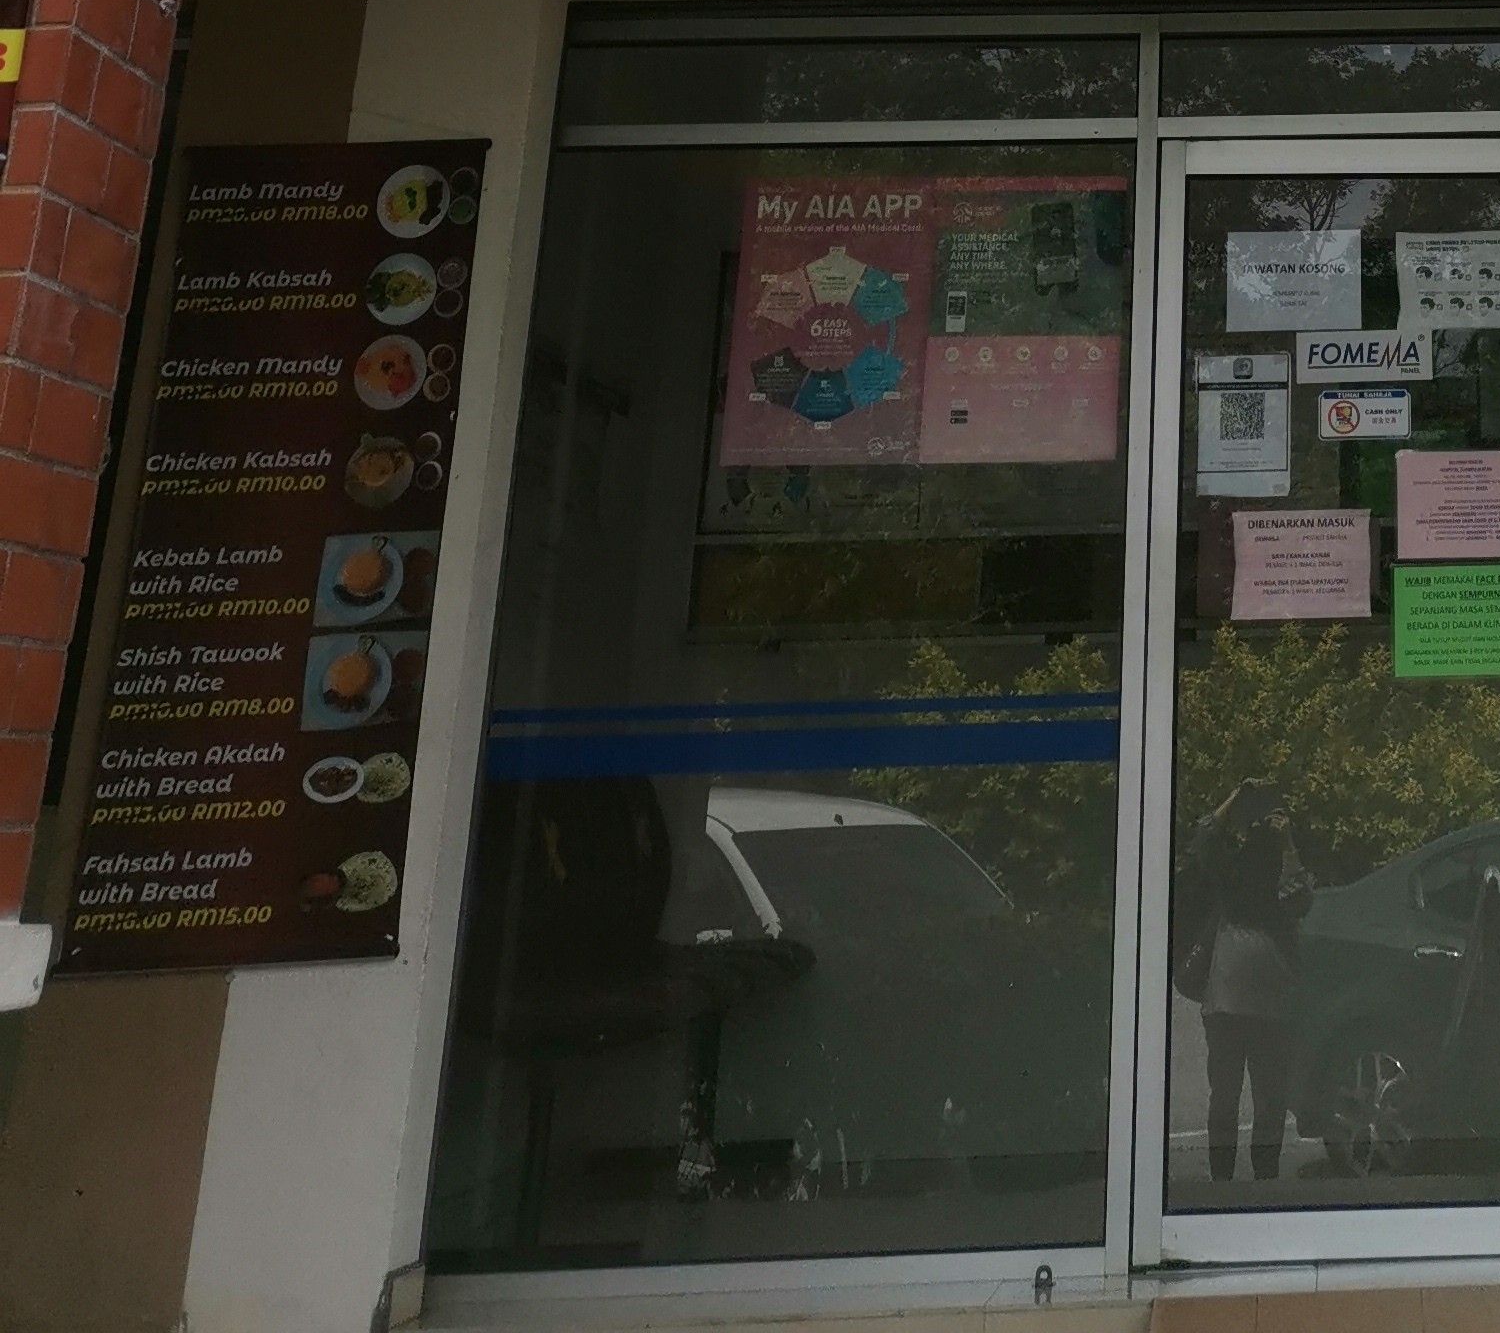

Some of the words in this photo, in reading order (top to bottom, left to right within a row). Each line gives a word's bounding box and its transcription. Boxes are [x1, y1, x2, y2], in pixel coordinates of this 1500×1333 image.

[189, 183, 253, 201] Lamb
[259, 181, 344, 202] Mandy
[281, 204, 368, 221] RM18.00
[757, 194, 799, 224] My
[805, 194, 855, 219] AIA
[862, 194, 923, 219] APP
[1299, 263, 1346, 274] KOSONG
[177, 272, 240, 291] Lamb
[246, 269, 333, 289] Kabsah
[269, 293, 357, 311] RM18.00
[810, 319, 823, 337] 6
[823, 318, 848, 327] EASY
[822, 327, 853, 337] STEPS
[160, 357, 249, 377] Chicken
[256, 355, 344, 376] Mandy
[248, 380, 339, 398] RM10.00
[146, 452, 237, 472] Chicken
[243, 448, 332, 470] Kabsah
[235, 474, 326, 493] RM10.00
[1248, 518, 1315, 530] DIBENARKAN
[1317, 517, 1355, 528] MASUK
[133, 547, 210, 568] Kebab
[216, 545, 283, 565] Lamb
[129, 574, 182, 595] with
[188, 573, 239, 593] Rice
[1405, 576, 1431, 585] WAJIB
[1433, 576, 1475, 585] MEMAKAI
[1476, 576, 1496, 584] FACE
[218, 597, 311, 616] RM10.00
[1422, 591, 1458, 600] DENGAN
[117, 645, 182, 667] Shish
[191, 641, 286, 664] Tawook
[113, 673, 167, 695] with
[173, 672, 225, 693] Rice
[208, 697, 295, 718] RM8.00
[101, 746, 198, 770] Chicken
[203, 742, 286, 765] Akdah
[96, 776, 151, 799] with
[156, 773, 234, 796] Bread
[191, 799, 286, 821] RM12.00
[83, 850, 175, 874] Fahsah
[181, 847, 253, 871] Lamb
[78, 881, 134, 905] with
[140, 878, 218, 902] Bread
[175, 905, 273, 928] RM15.00
